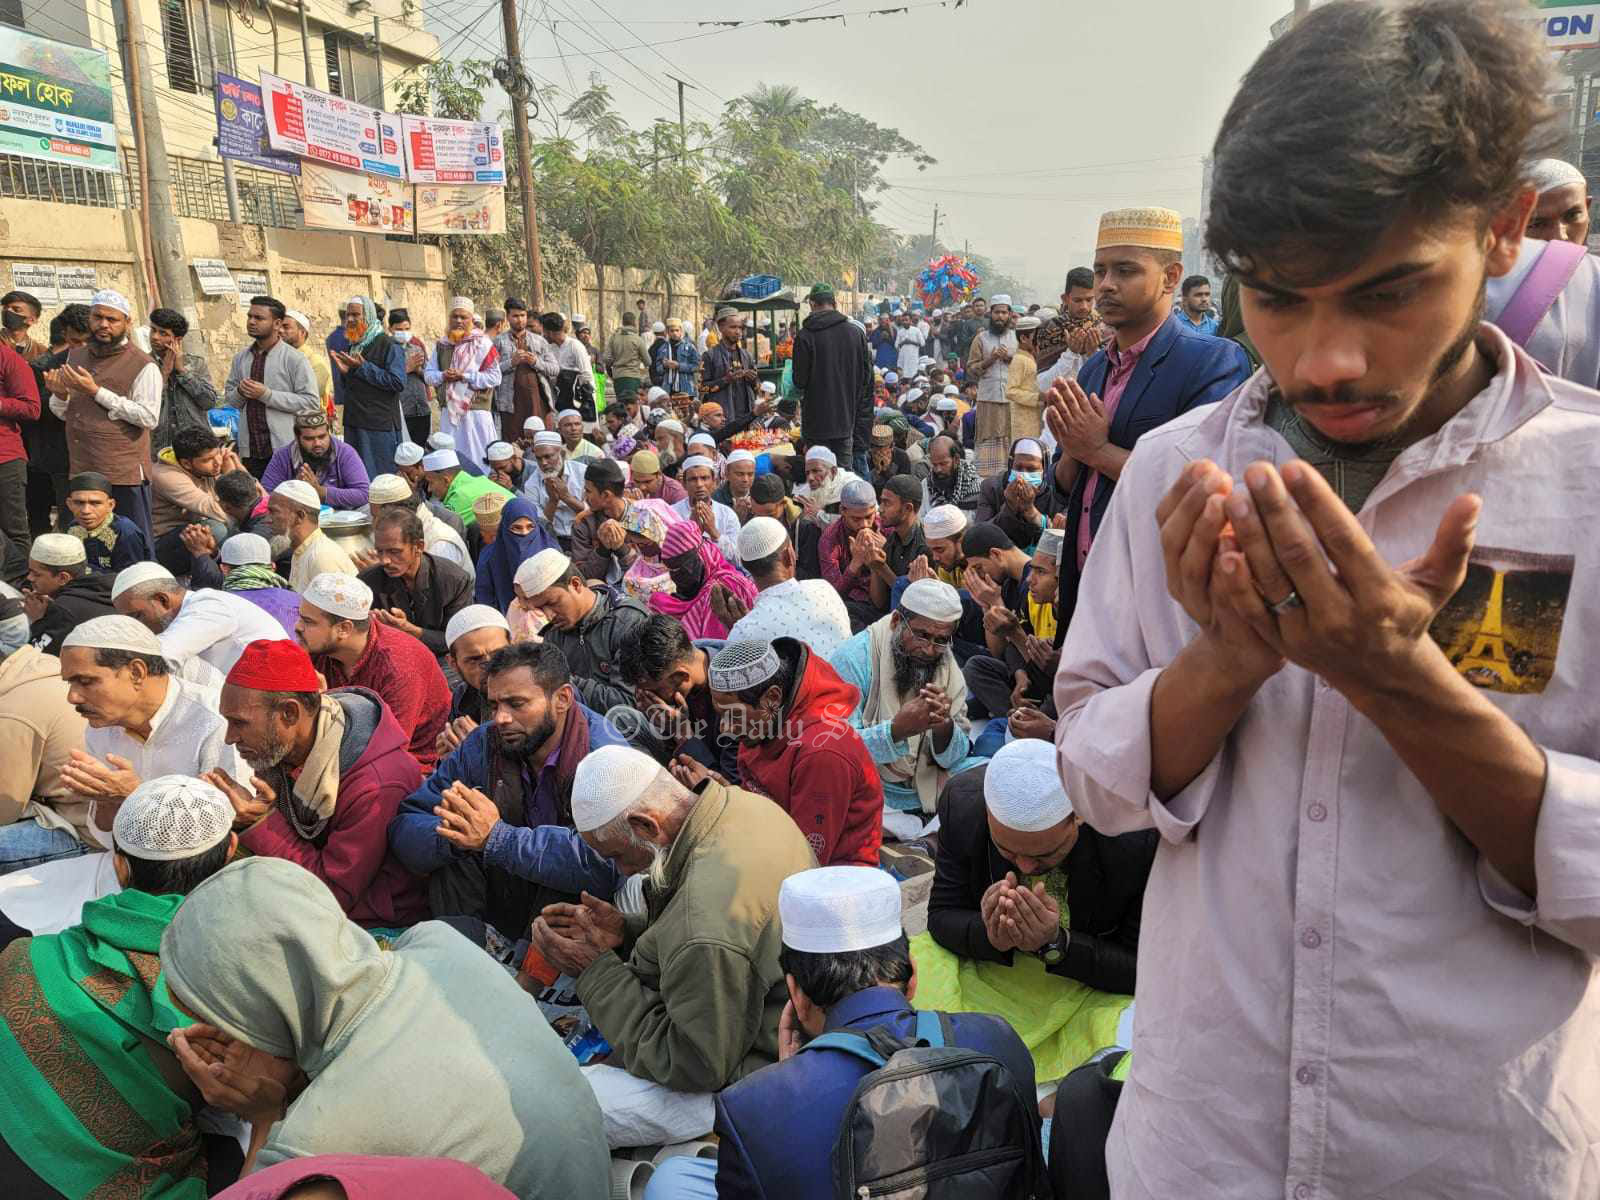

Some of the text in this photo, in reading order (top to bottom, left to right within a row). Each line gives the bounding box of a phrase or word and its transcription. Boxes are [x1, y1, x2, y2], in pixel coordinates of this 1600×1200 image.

[1544, 14, 1594, 36] ON
[0, 72, 75, 108] ফল হোক
